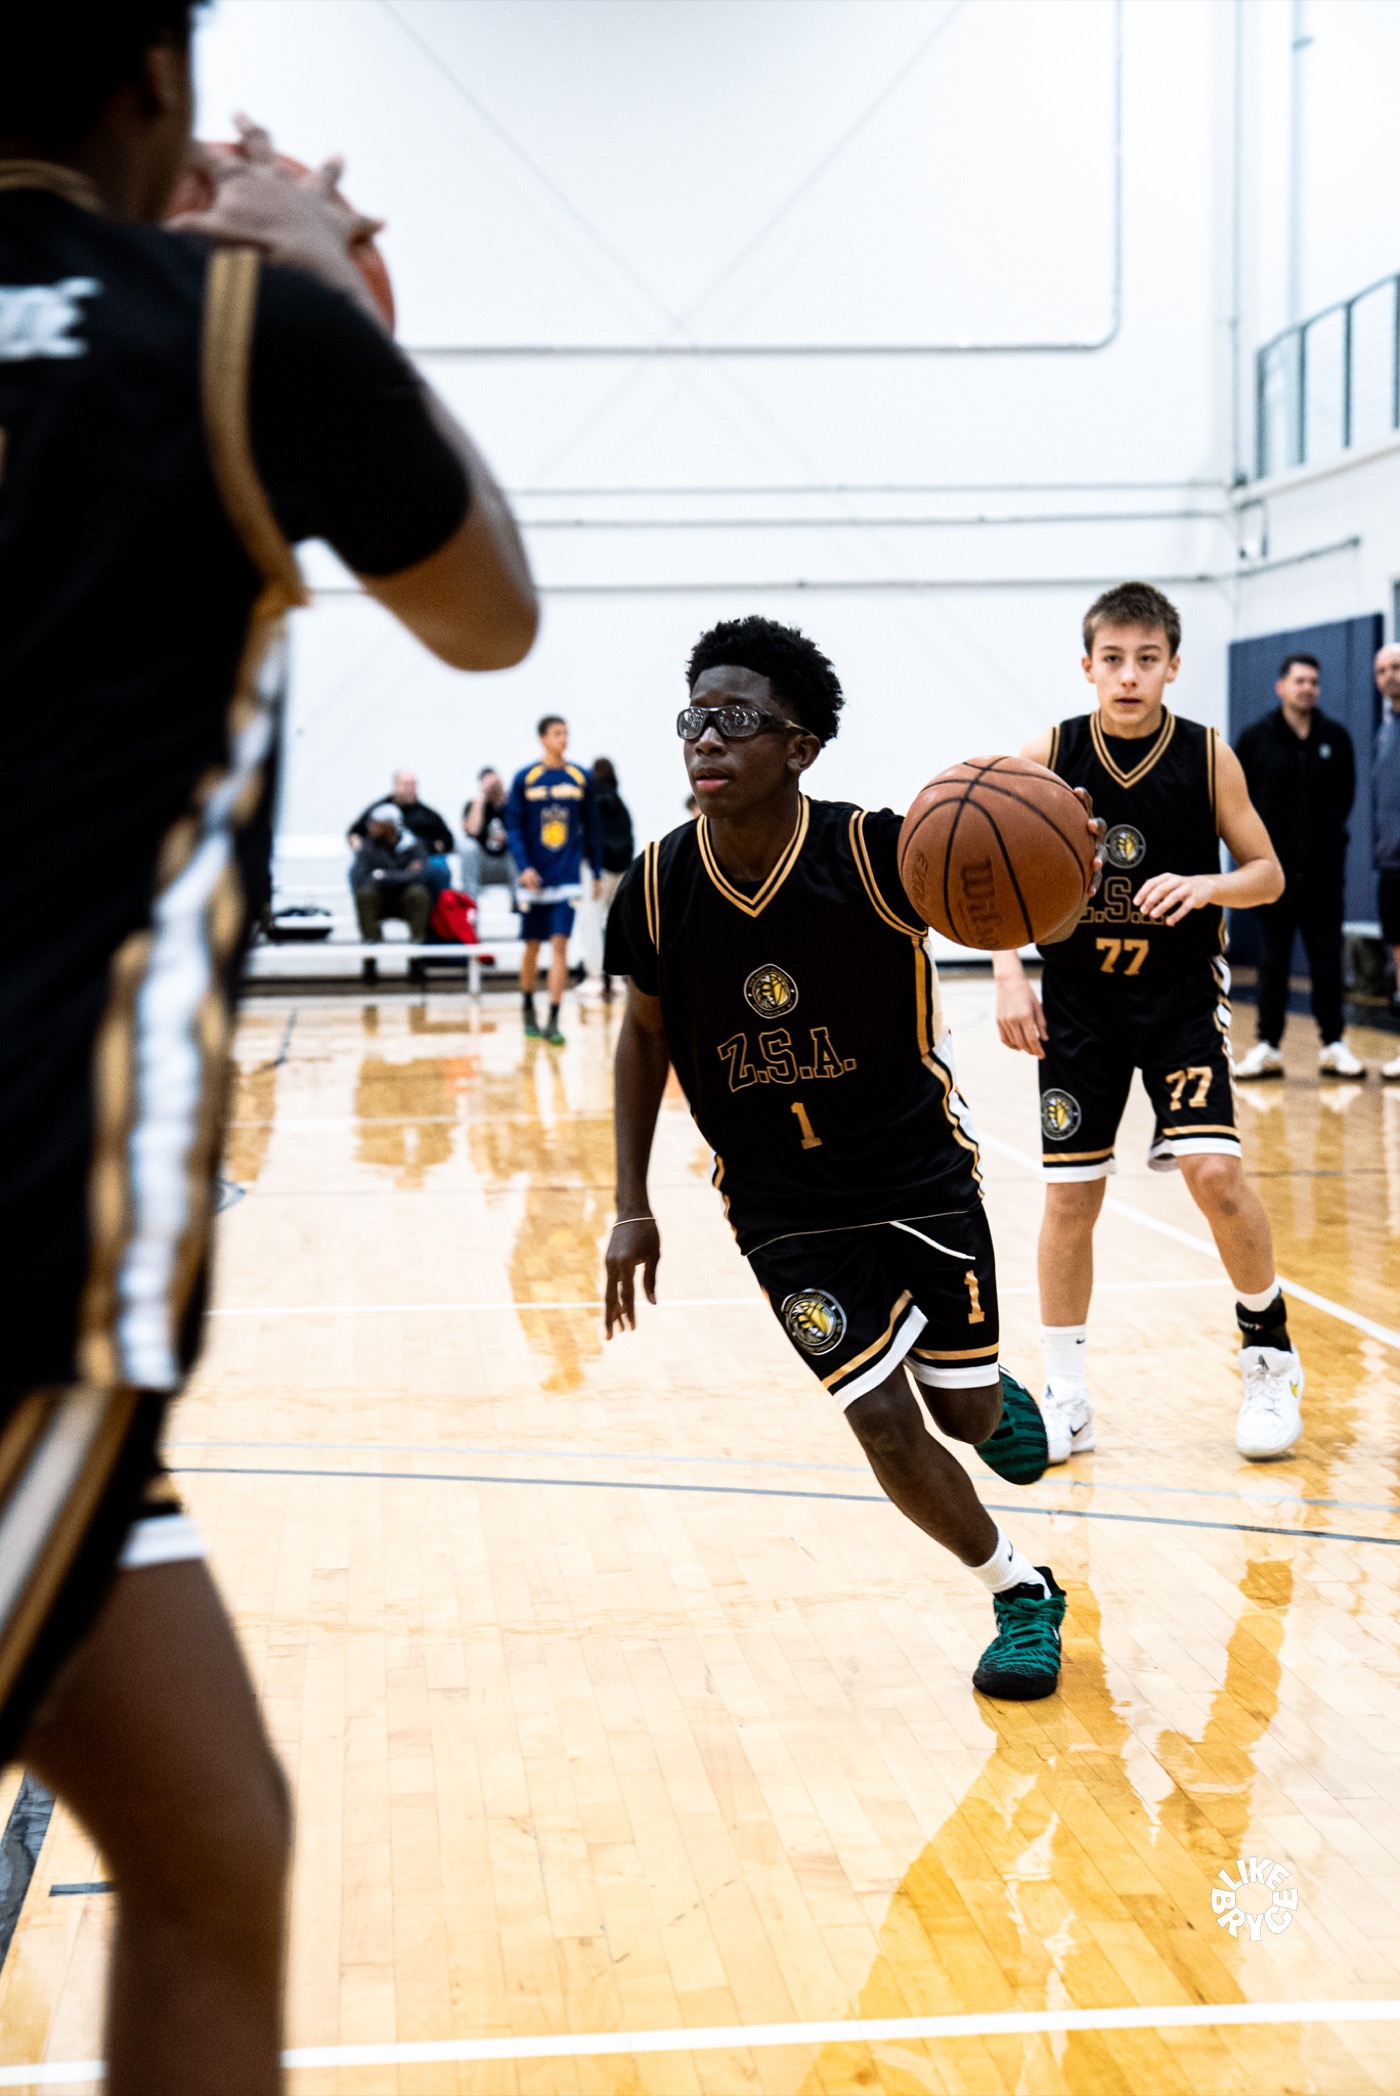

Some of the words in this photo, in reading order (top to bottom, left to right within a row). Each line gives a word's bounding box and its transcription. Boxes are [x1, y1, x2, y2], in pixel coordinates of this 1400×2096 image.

[1095, 937, 1149, 976] 77
[717, 1026, 857, 1092] Z.S.A.
[1165, 1066, 1213, 1111] 77
[790, 1102, 823, 1150] 1
[963, 1269, 985, 1324] 1
